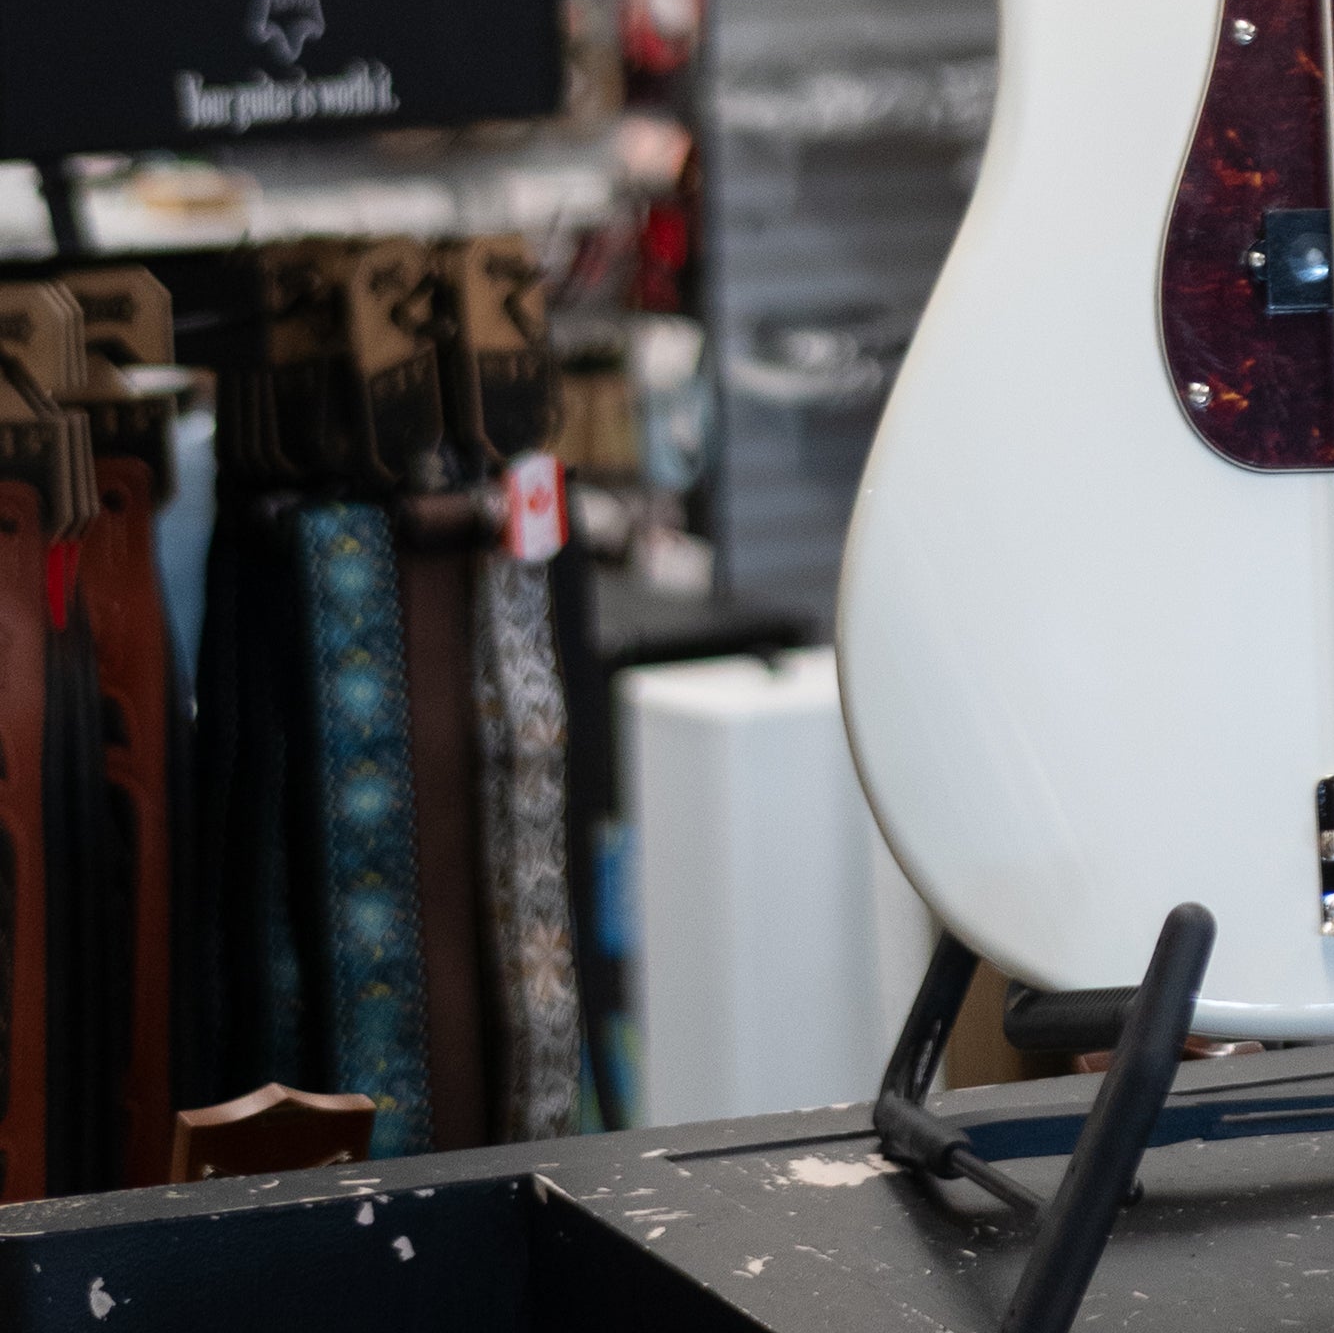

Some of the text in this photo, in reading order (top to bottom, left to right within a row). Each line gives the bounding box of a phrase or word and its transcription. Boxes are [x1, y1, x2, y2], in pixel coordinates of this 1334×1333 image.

[176, 71, 231, 129] Your
[230, 69, 292, 134] guitar
[291, 67, 317, 121] is
[316, 58, 375, 116] worth
